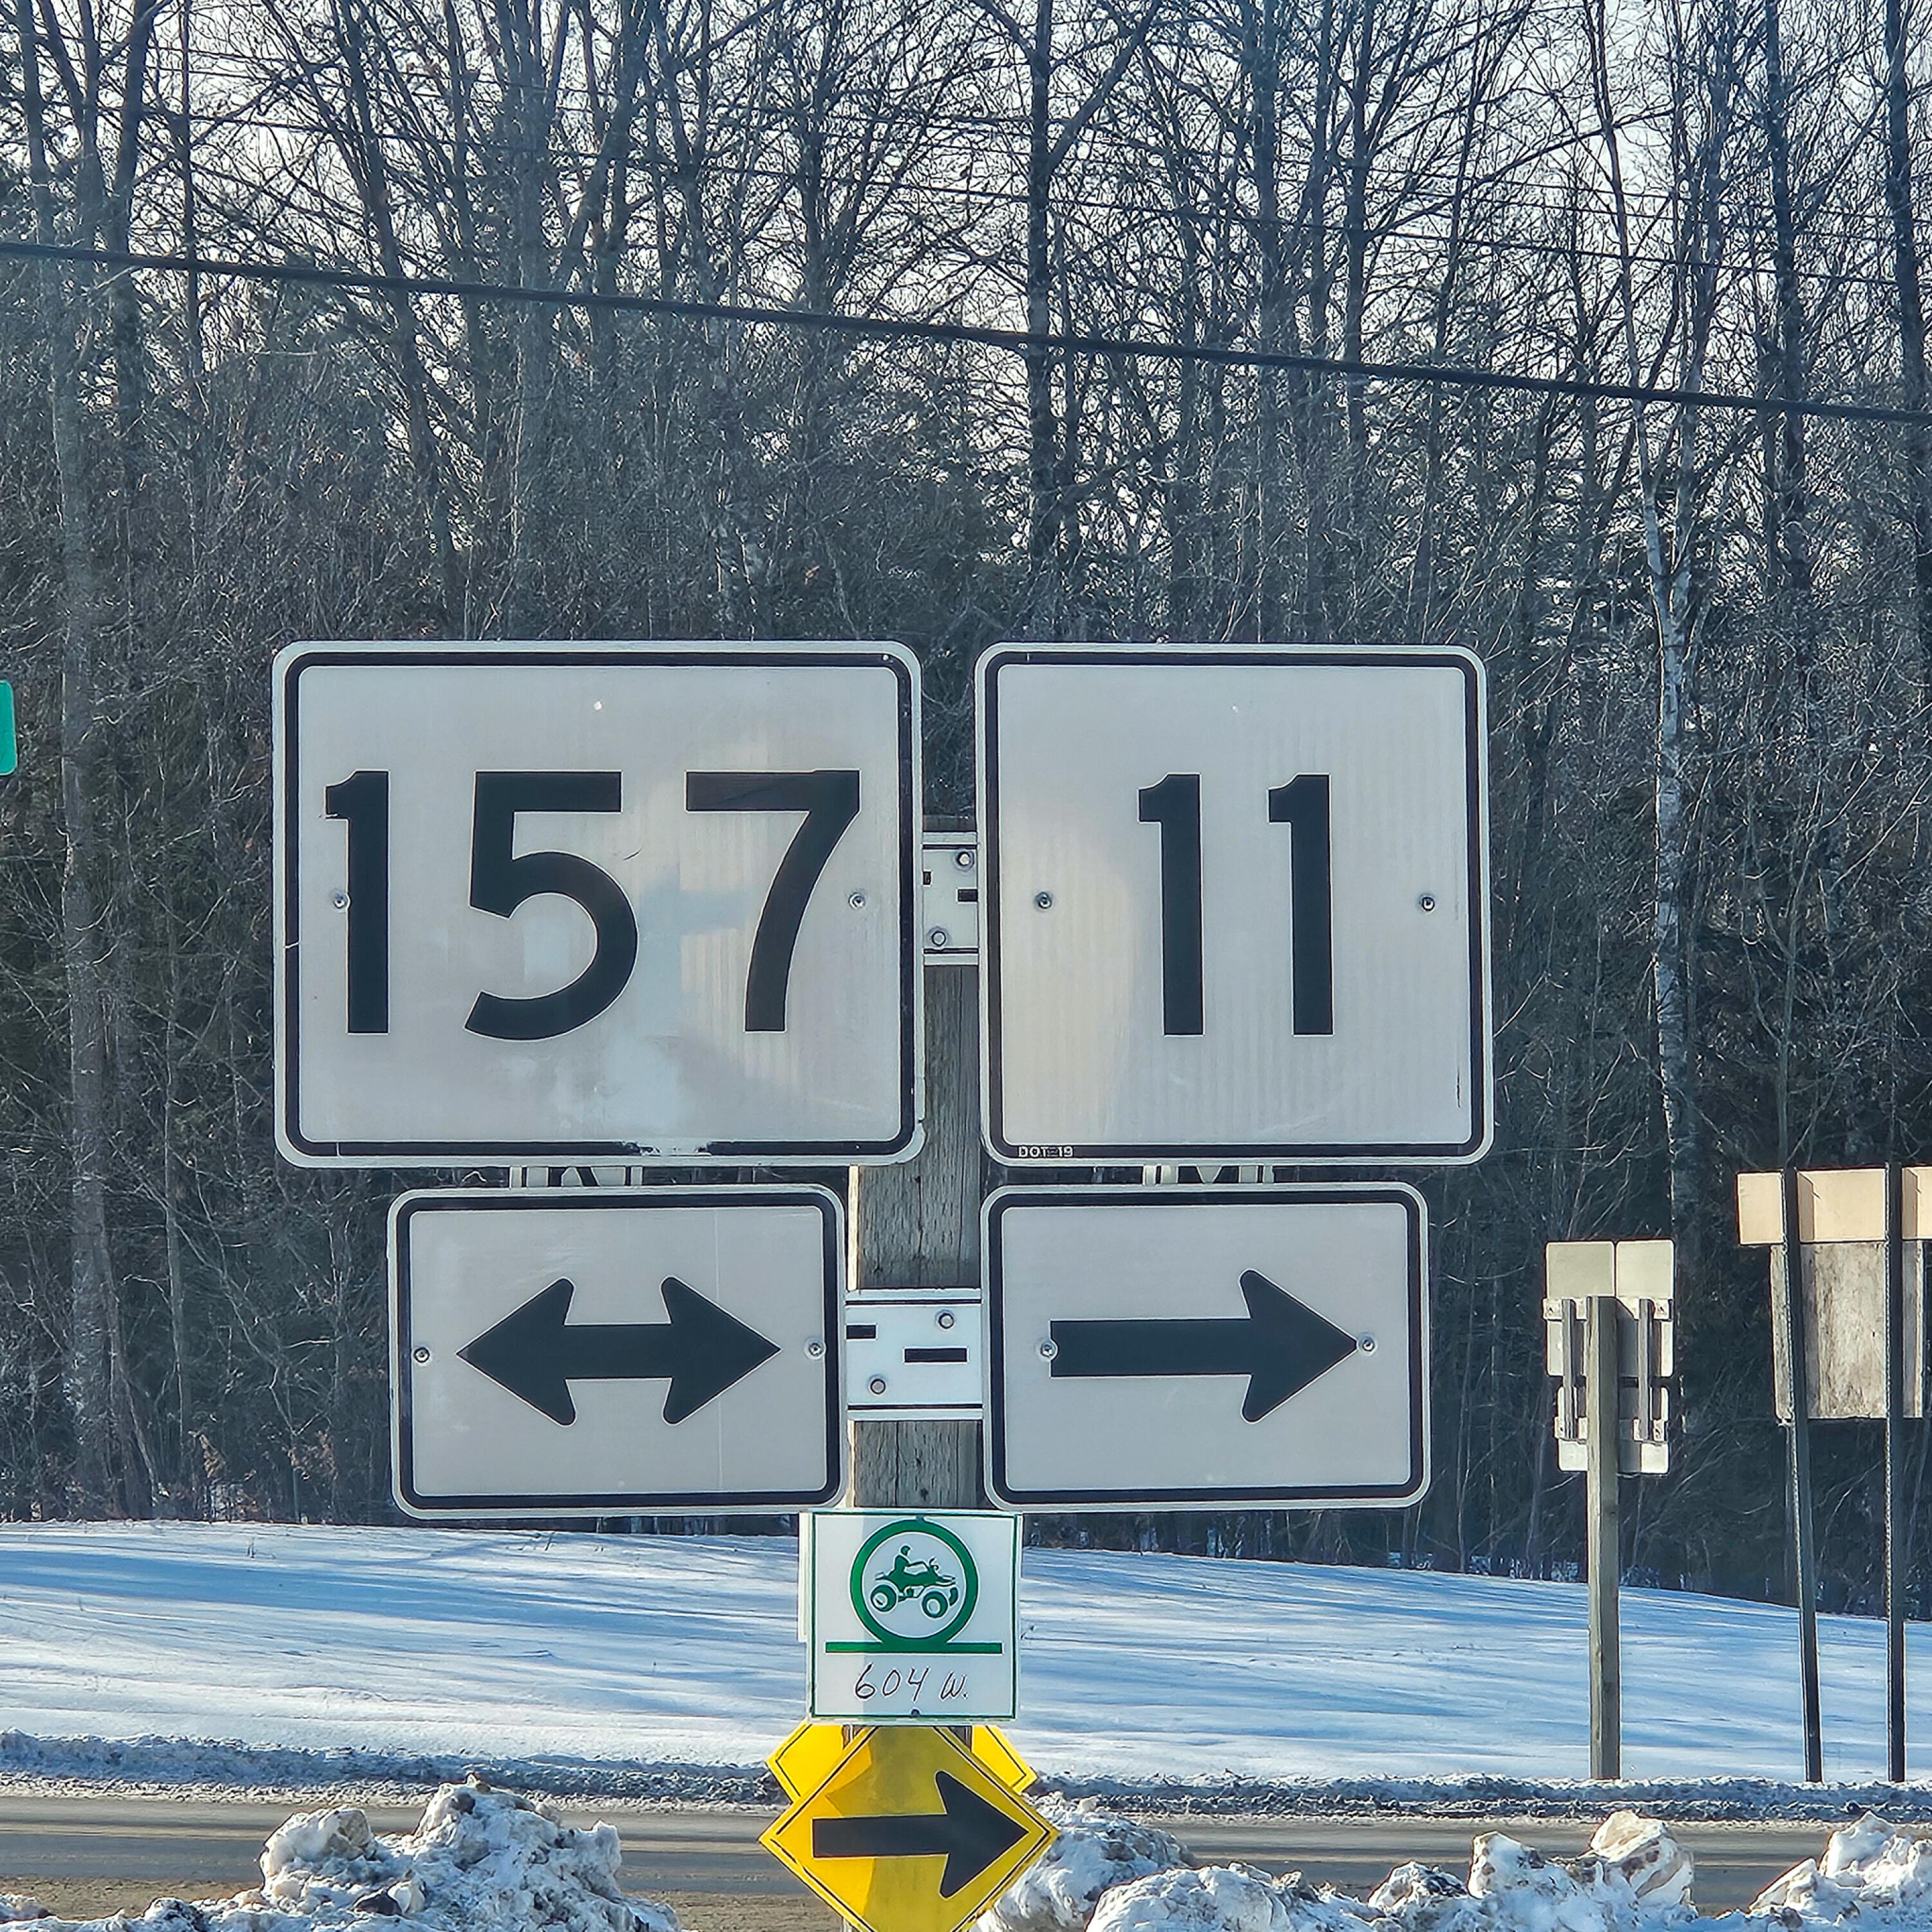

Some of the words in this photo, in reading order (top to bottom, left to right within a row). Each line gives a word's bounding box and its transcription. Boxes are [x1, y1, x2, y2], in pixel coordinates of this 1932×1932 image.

[325, 770, 860, 1041] 157
[1139, 774, 1333, 1036] 11
[855, 1663, 929, 1701] 604
